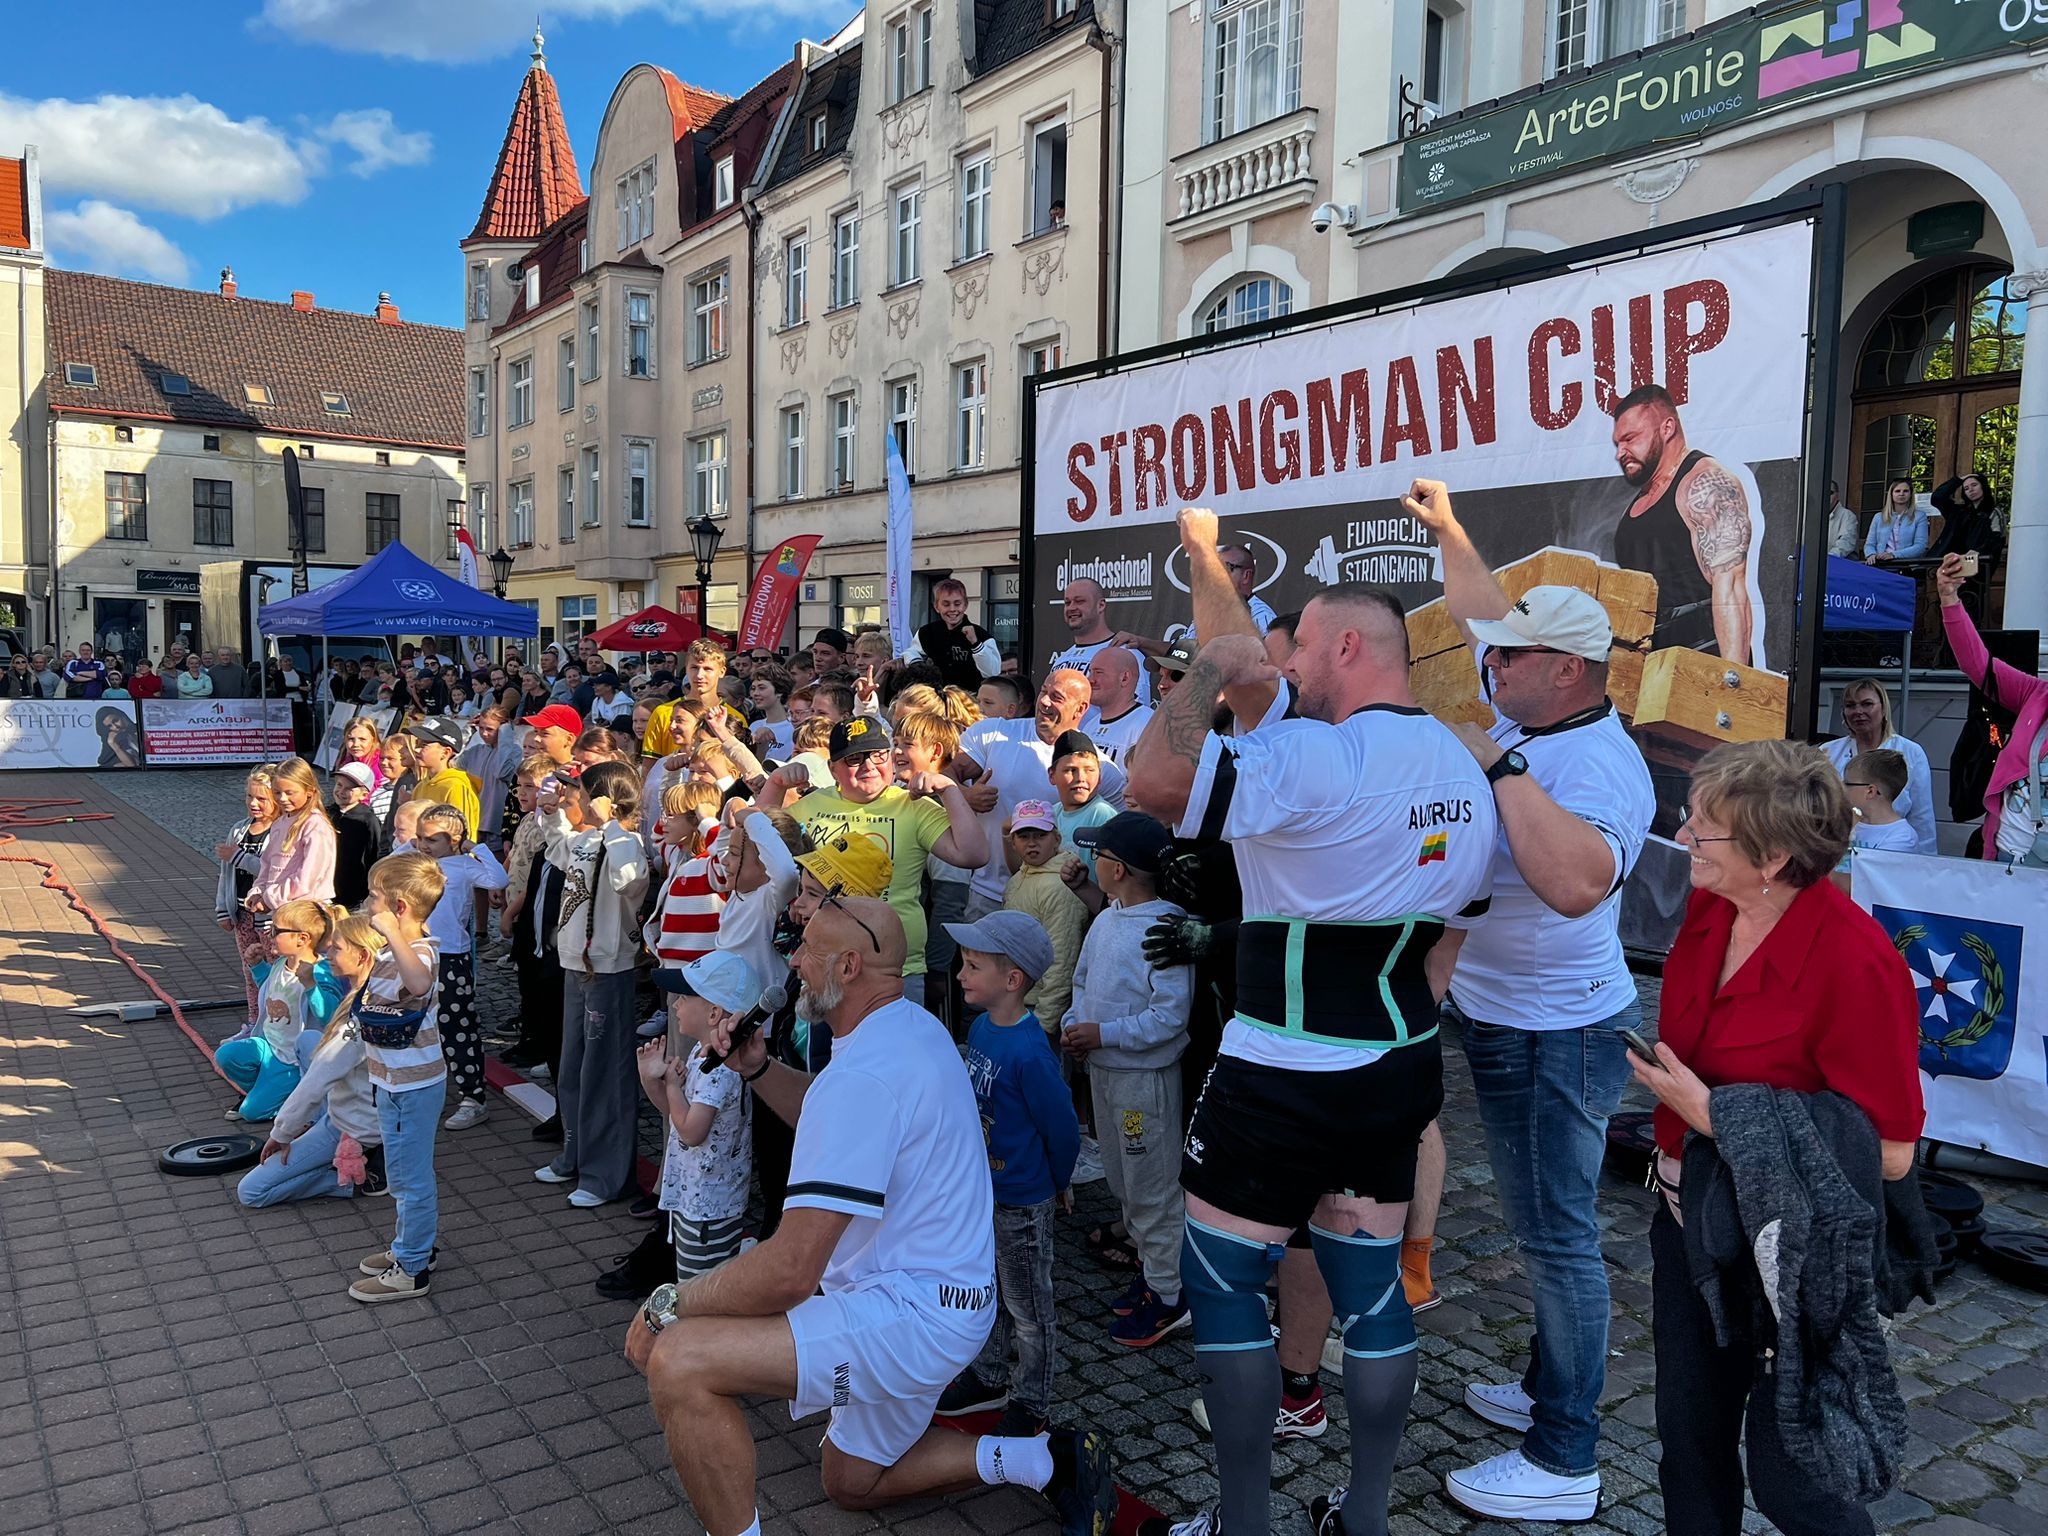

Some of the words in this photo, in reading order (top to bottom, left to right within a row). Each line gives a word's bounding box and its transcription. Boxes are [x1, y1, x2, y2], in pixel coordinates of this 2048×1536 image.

[1513, 47, 1745, 154] ArteFonie
[1680, 94, 1743, 125] WOLNOŚĆ
[1419, 142, 1459, 159] WEJHEROWA
[1459, 131, 1492, 148] ZAPRASZA
[1420, 135, 1454, 151] PREZYDENT
[1454, 128, 1477, 141] MIASTA
[1509, 165, 1516, 175] V
[1517, 150, 1564, 172] FESTIWAL
[1066, 335, 1497, 523] STRONGMAN
[1527, 278, 1730, 430] CUP
[1345, 554, 1428, 584] STRONGMAN
[849, 585, 874, 599] ROSSI
[1823, 592, 1876, 614] erowo.pl
[744, 574, 775, 646] WEJHEROWO
[374, 615, 495, 629] www.wejherowo.pl
[625, 620, 668, 633] Coca-Cola
[0, 713, 93, 729] STHETIC
[187, 712, 253, 725] ARKABUD
[866, 816, 889, 824] HERE
[1077, 839, 1097, 847] FRANCE
